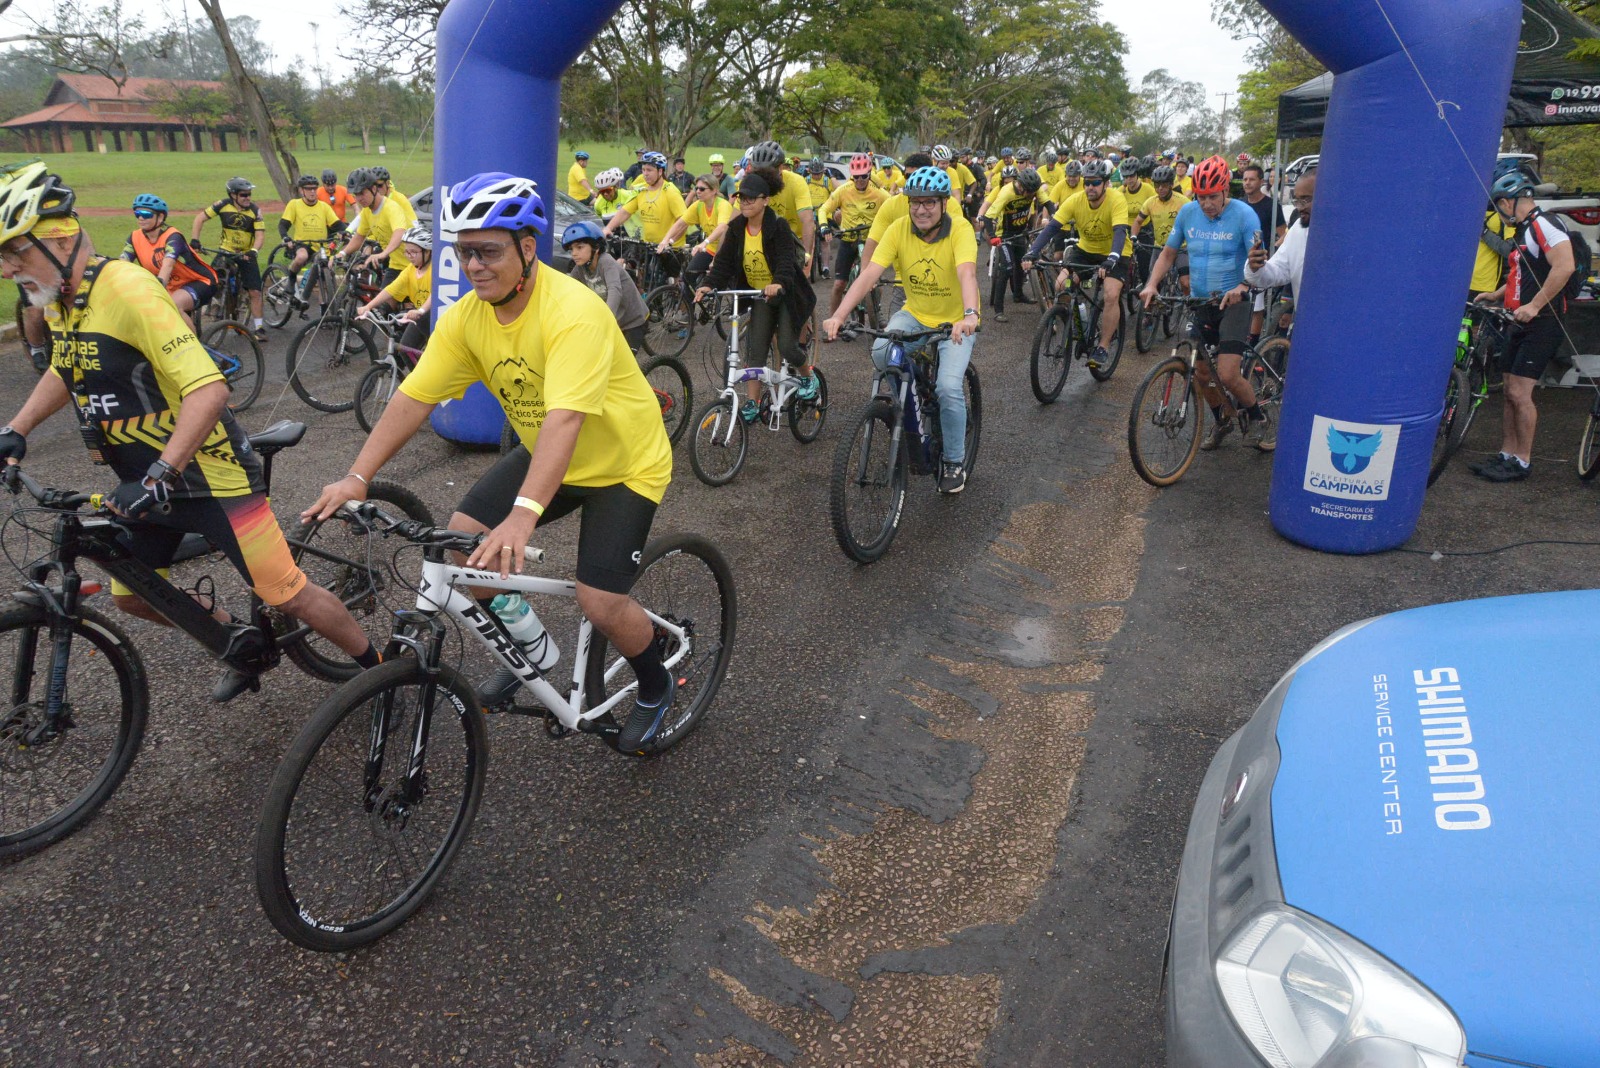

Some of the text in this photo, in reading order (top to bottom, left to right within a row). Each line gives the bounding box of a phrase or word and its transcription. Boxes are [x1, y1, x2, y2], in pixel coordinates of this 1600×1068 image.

[1567, 89, 1579, 97] 19
[1195, 229, 1233, 240] flashbike
[162, 333, 196, 355] STAFF
[1310, 471, 1367, 484] PREFEITURA
[1310, 477, 1383, 494] CAMPINAS
[1311, 506, 1373, 520] TRANSPORTES
[1321, 502, 1363, 513] SECRETARIA
[461, 605, 546, 682] FIRST
[1373, 673, 1403, 835] SERVICE CENTER
[1413, 667, 1491, 831] SHIMANO
